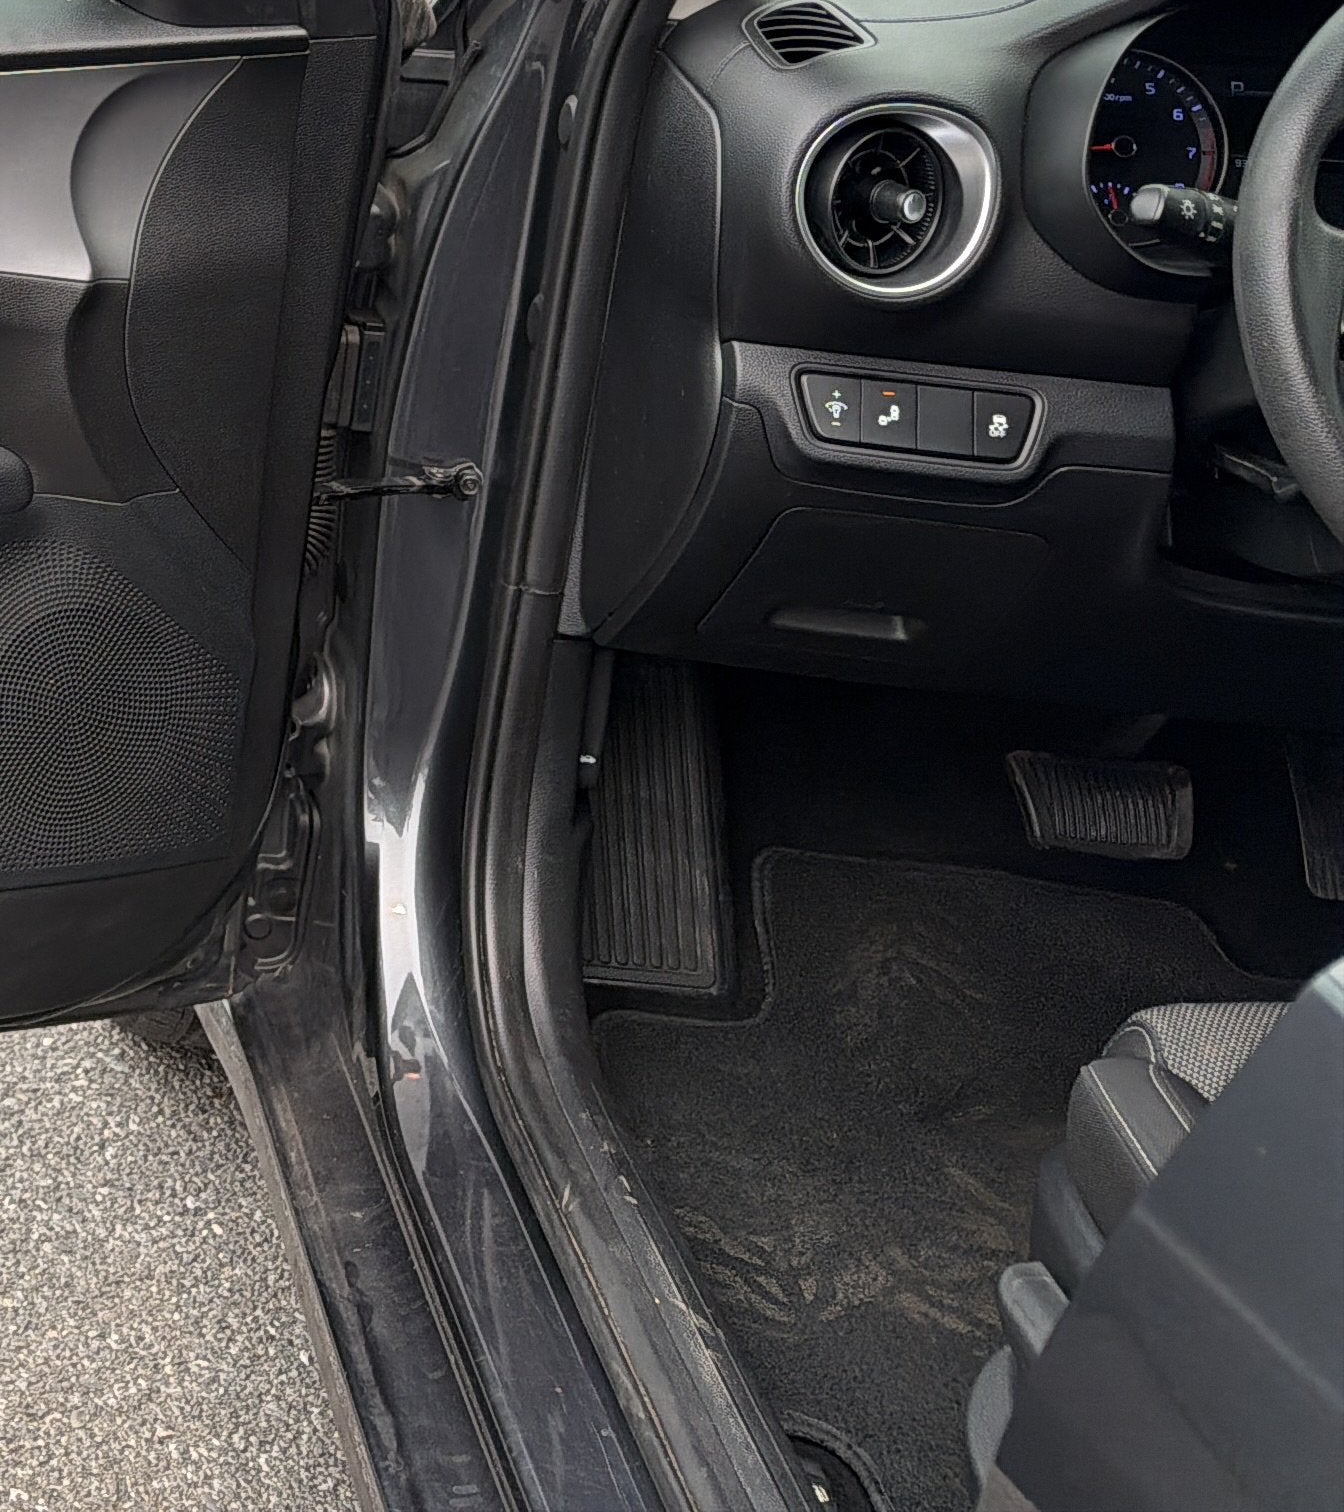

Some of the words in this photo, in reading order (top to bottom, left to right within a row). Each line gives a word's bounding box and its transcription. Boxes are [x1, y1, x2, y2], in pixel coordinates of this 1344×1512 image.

[1145, 82, 1156, 95] 5
[1172, 108, 1184, 121] 6
[1186, 146, 1197, 159] 7
